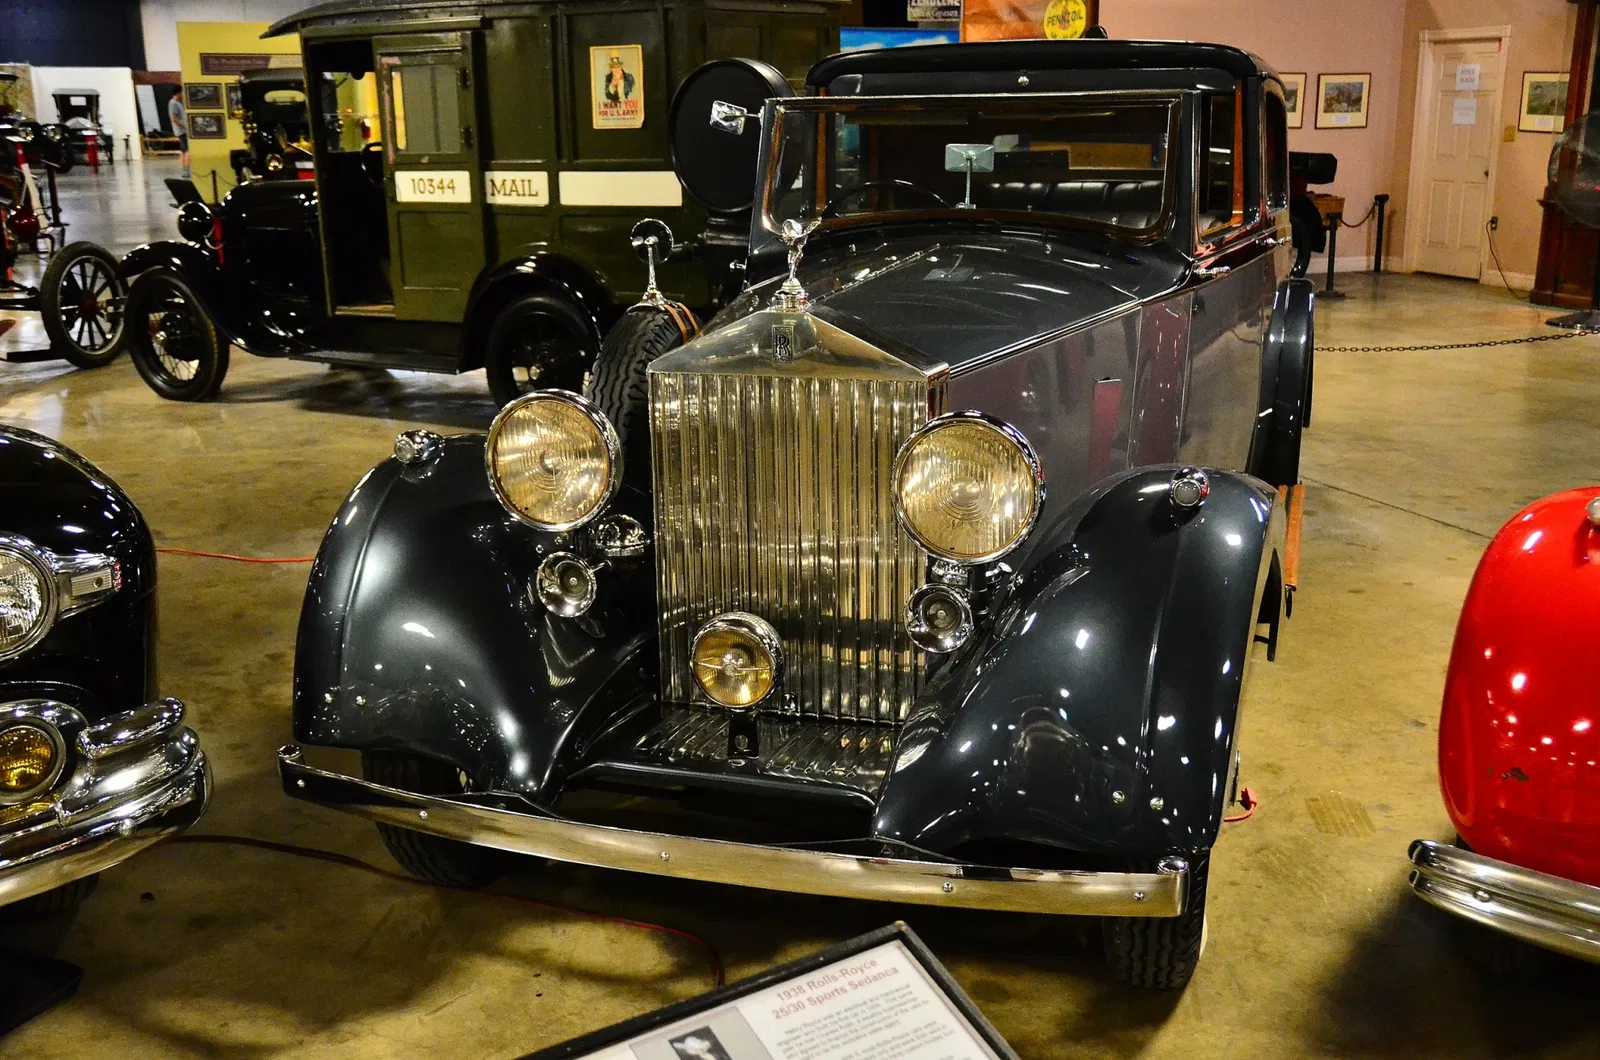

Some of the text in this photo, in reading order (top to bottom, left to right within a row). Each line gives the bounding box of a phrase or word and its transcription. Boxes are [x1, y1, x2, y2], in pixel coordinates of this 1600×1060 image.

[603, 101, 622, 109] WANT
[623, 100, 638, 109] YOU
[622, 109, 638, 117] ARMY
[411, 178, 456, 195] 10344
[489, 178, 539, 197] MAIL
[777, 960, 878, 1002] 1938 Rolls-Royce
[771, 1001, 806, 1019] 25/30
[807, 985, 848, 1006] Sports
[847, 966, 899, 990] Sedanca
